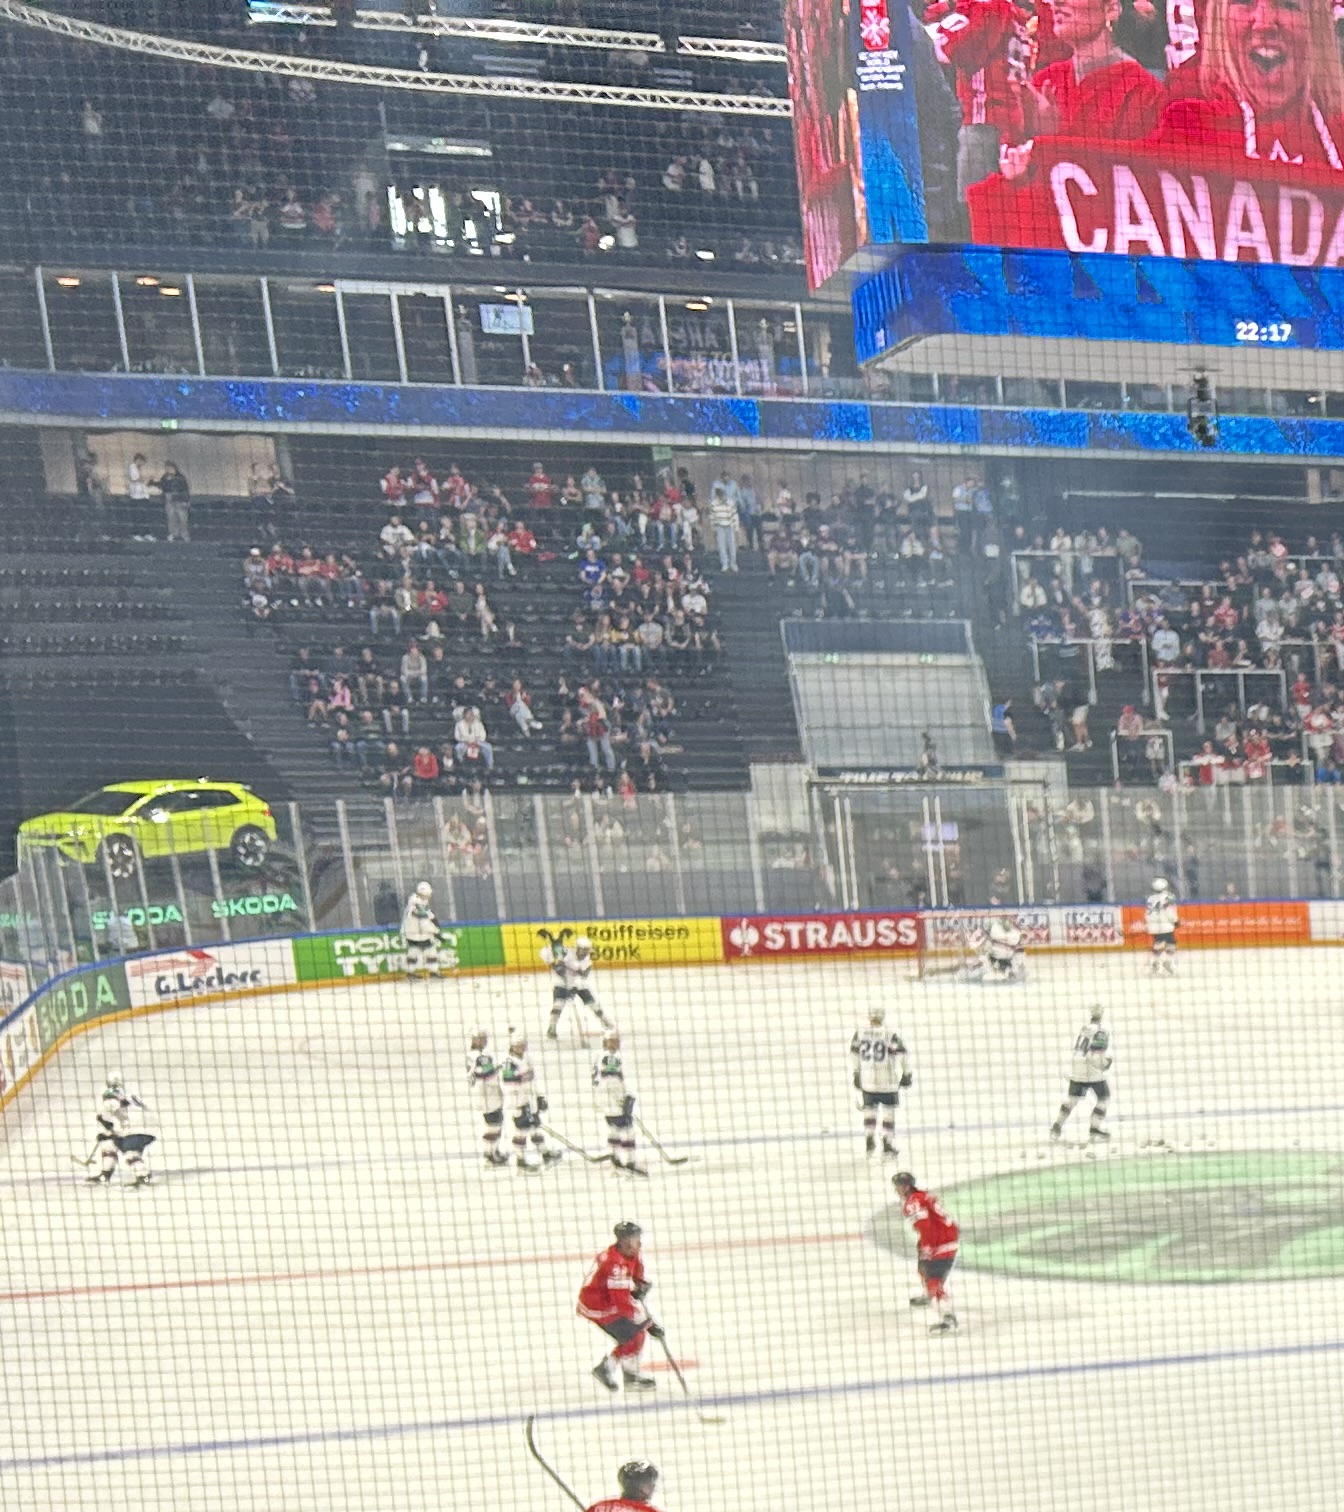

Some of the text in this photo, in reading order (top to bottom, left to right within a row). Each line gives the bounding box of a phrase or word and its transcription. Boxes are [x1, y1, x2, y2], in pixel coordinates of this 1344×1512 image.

[1236, 321, 1292, 342] 22:17
[92, 905, 183, 930] SODA
[586, 923, 689, 941] Raiffeisen
[763, 917, 918, 951] STRAUSS
